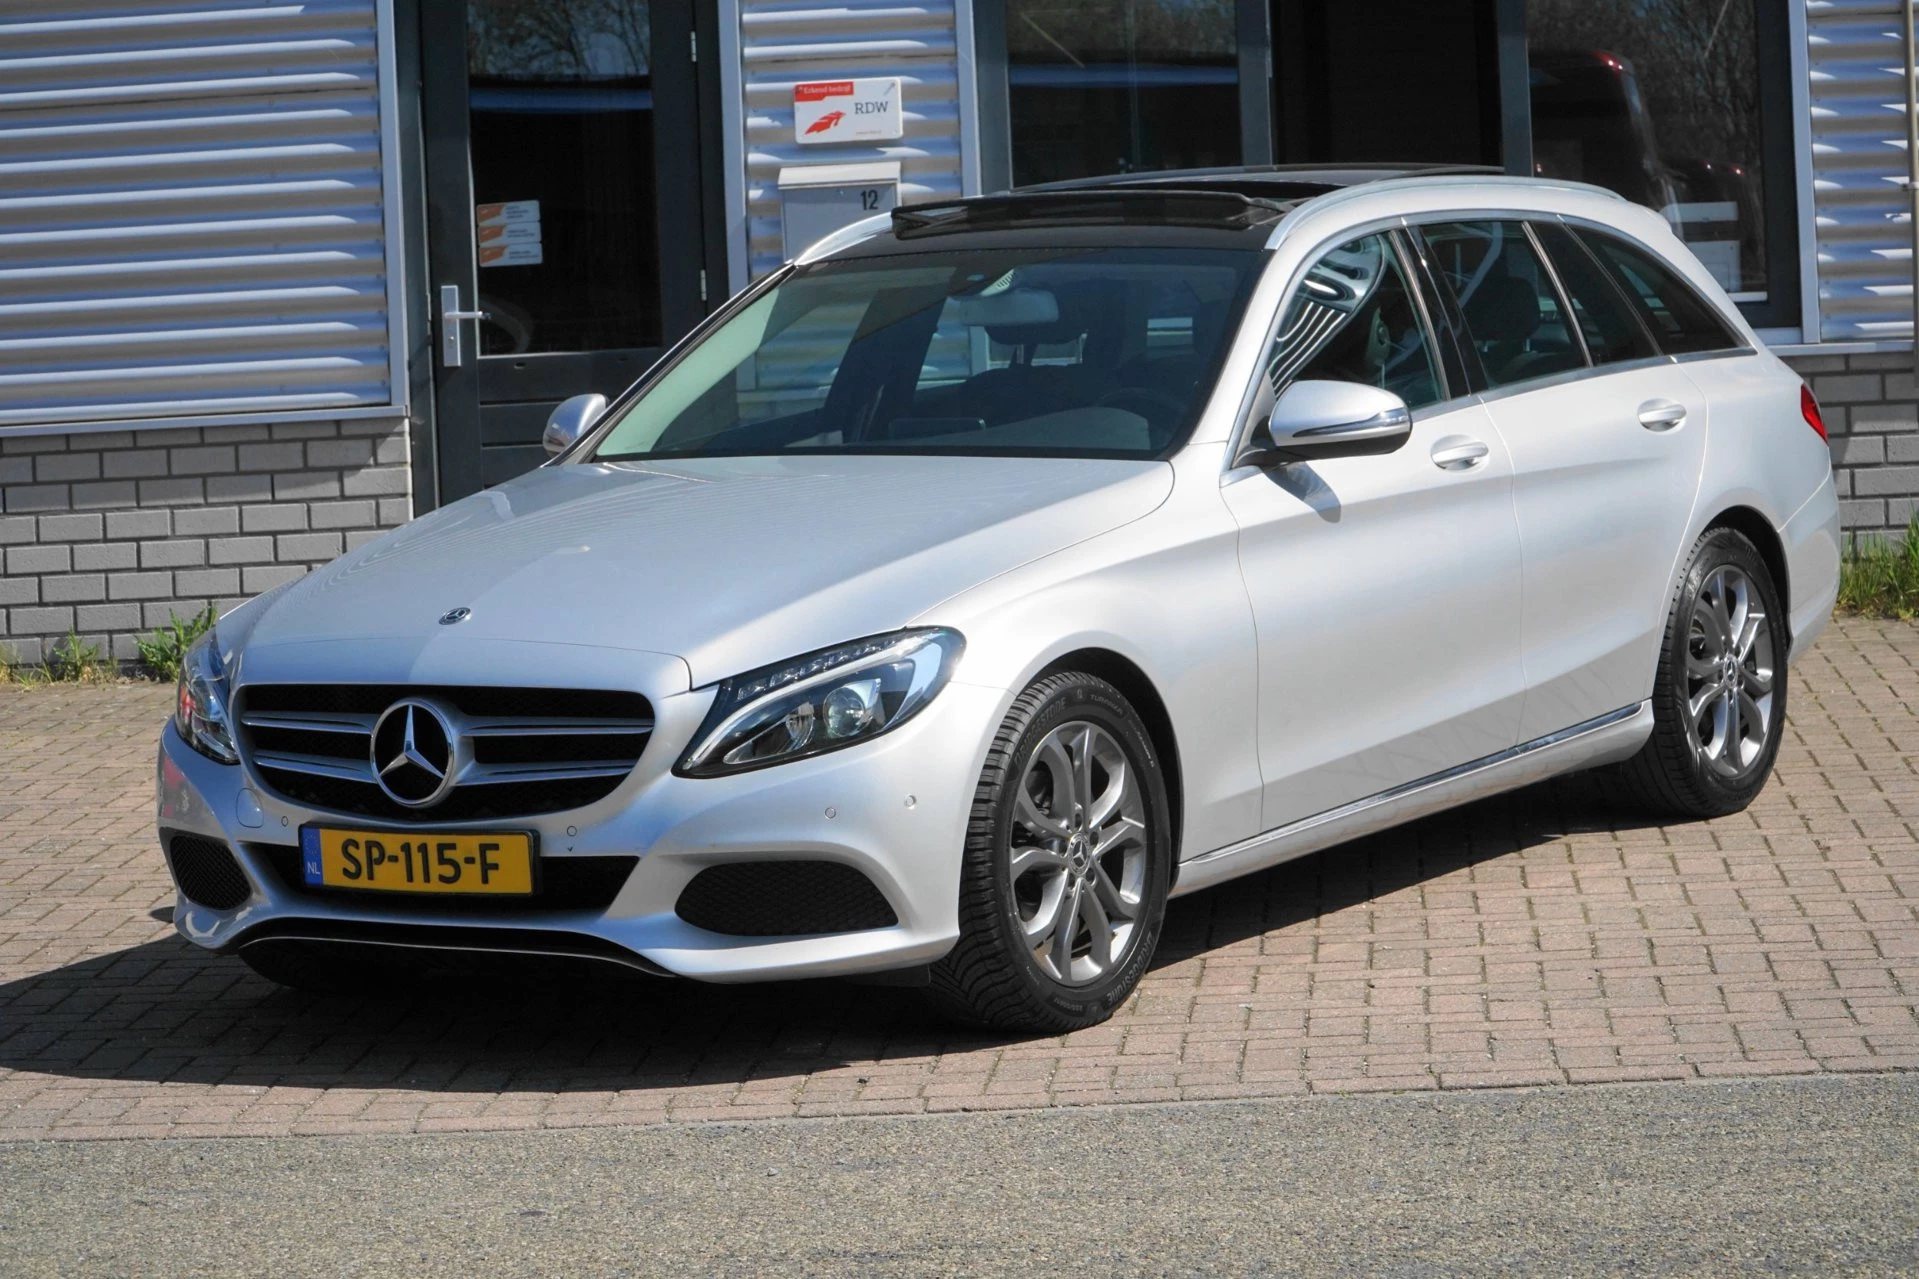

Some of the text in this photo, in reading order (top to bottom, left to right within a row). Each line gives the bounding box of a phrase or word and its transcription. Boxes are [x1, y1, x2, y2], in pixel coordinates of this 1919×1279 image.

[854, 101, 889, 115] RDW
[860, 189, 879, 211] 12
[307, 861, 321, 875] NL
[340, 837, 501, 885] SP-115-F
